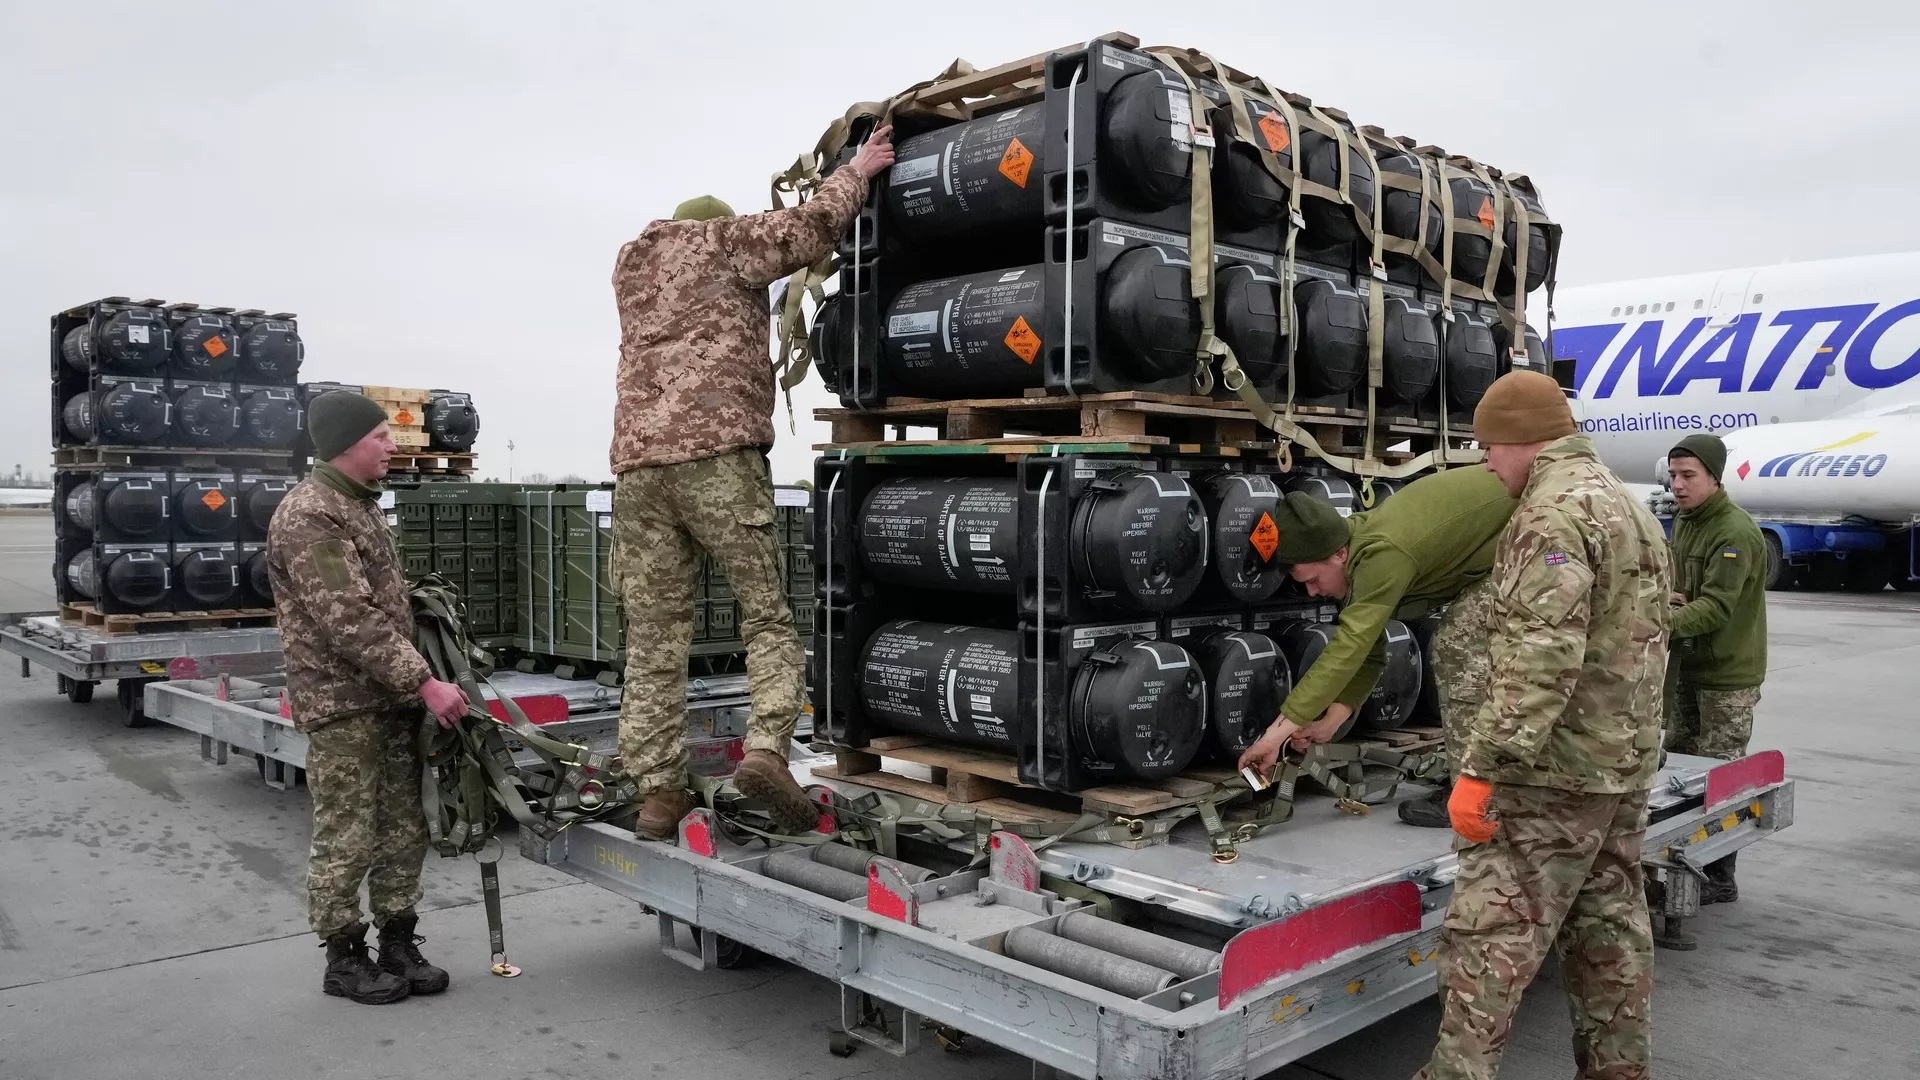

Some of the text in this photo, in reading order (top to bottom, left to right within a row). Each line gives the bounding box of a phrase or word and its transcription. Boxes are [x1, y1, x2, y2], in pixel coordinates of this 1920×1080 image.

[953, 125, 972, 212] CENTER OF BALANCE
[903, 196, 933, 209] DIRECTION
[915, 205, 935, 216] FLIGHT
[953, 283, 972, 369] CENTER OF BALANCE
[903, 351, 932, 360] DIRECTION
[915, 360, 934, 368] FLIGHT
[1798, 454, 1888, 477] КРЕБО
[938, 495, 958, 580] CENTER OF BALANCE
[975, 565, 1008, 574] DIRECTION
[886, 667, 911, 676] TEMPERATURE
[938, 649, 957, 734] CENTER OF BALANCE
[974, 722, 1007, 733] DIRECTION
[987, 731, 1010, 740] FLIGHT
